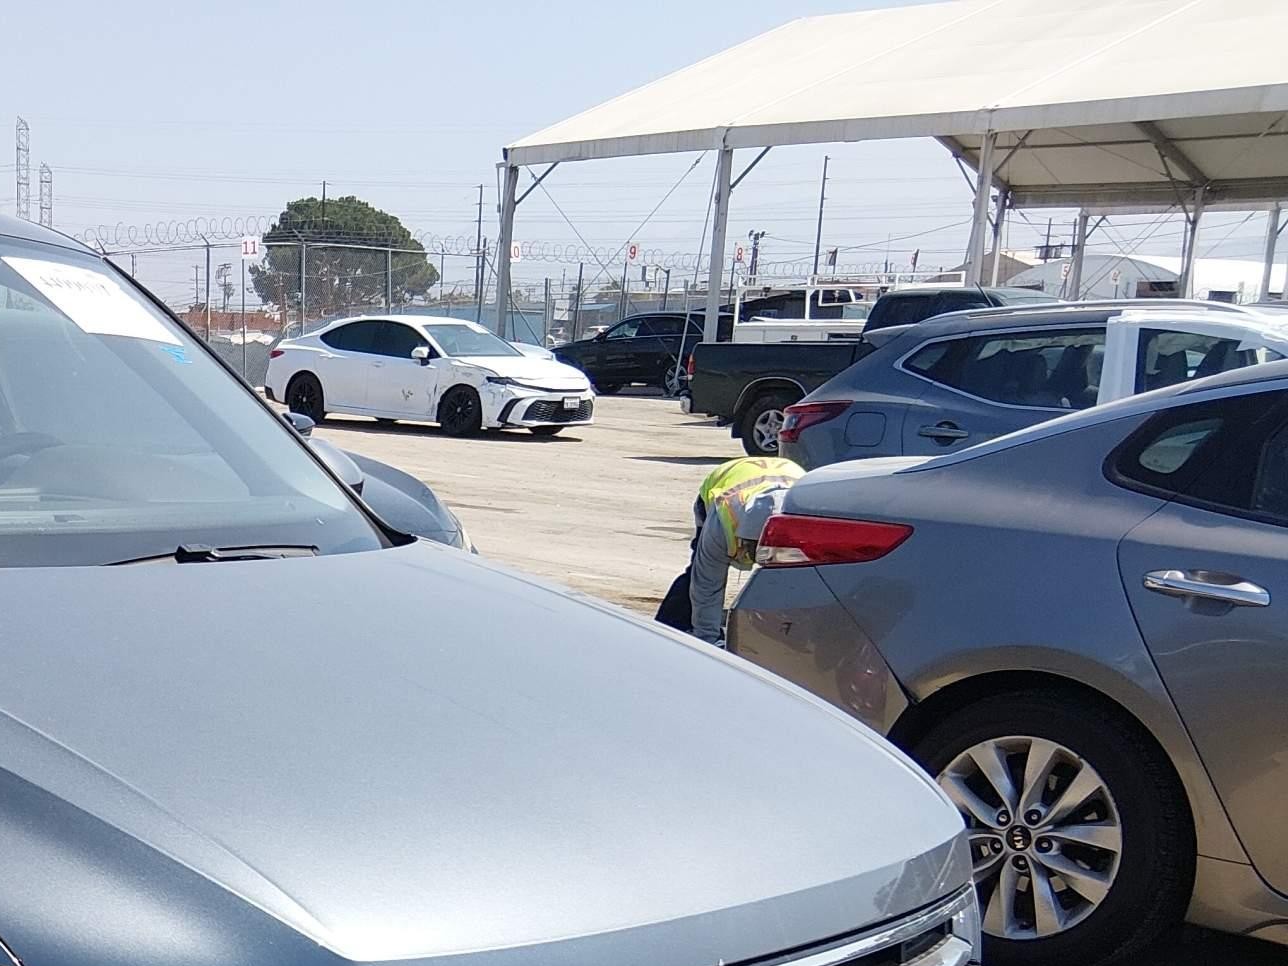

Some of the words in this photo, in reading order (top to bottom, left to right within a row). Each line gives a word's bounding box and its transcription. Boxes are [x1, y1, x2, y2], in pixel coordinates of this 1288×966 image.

[242, 240, 258, 255] 11
[629, 245, 637, 260] 9
[736, 247, 743, 261] 8
